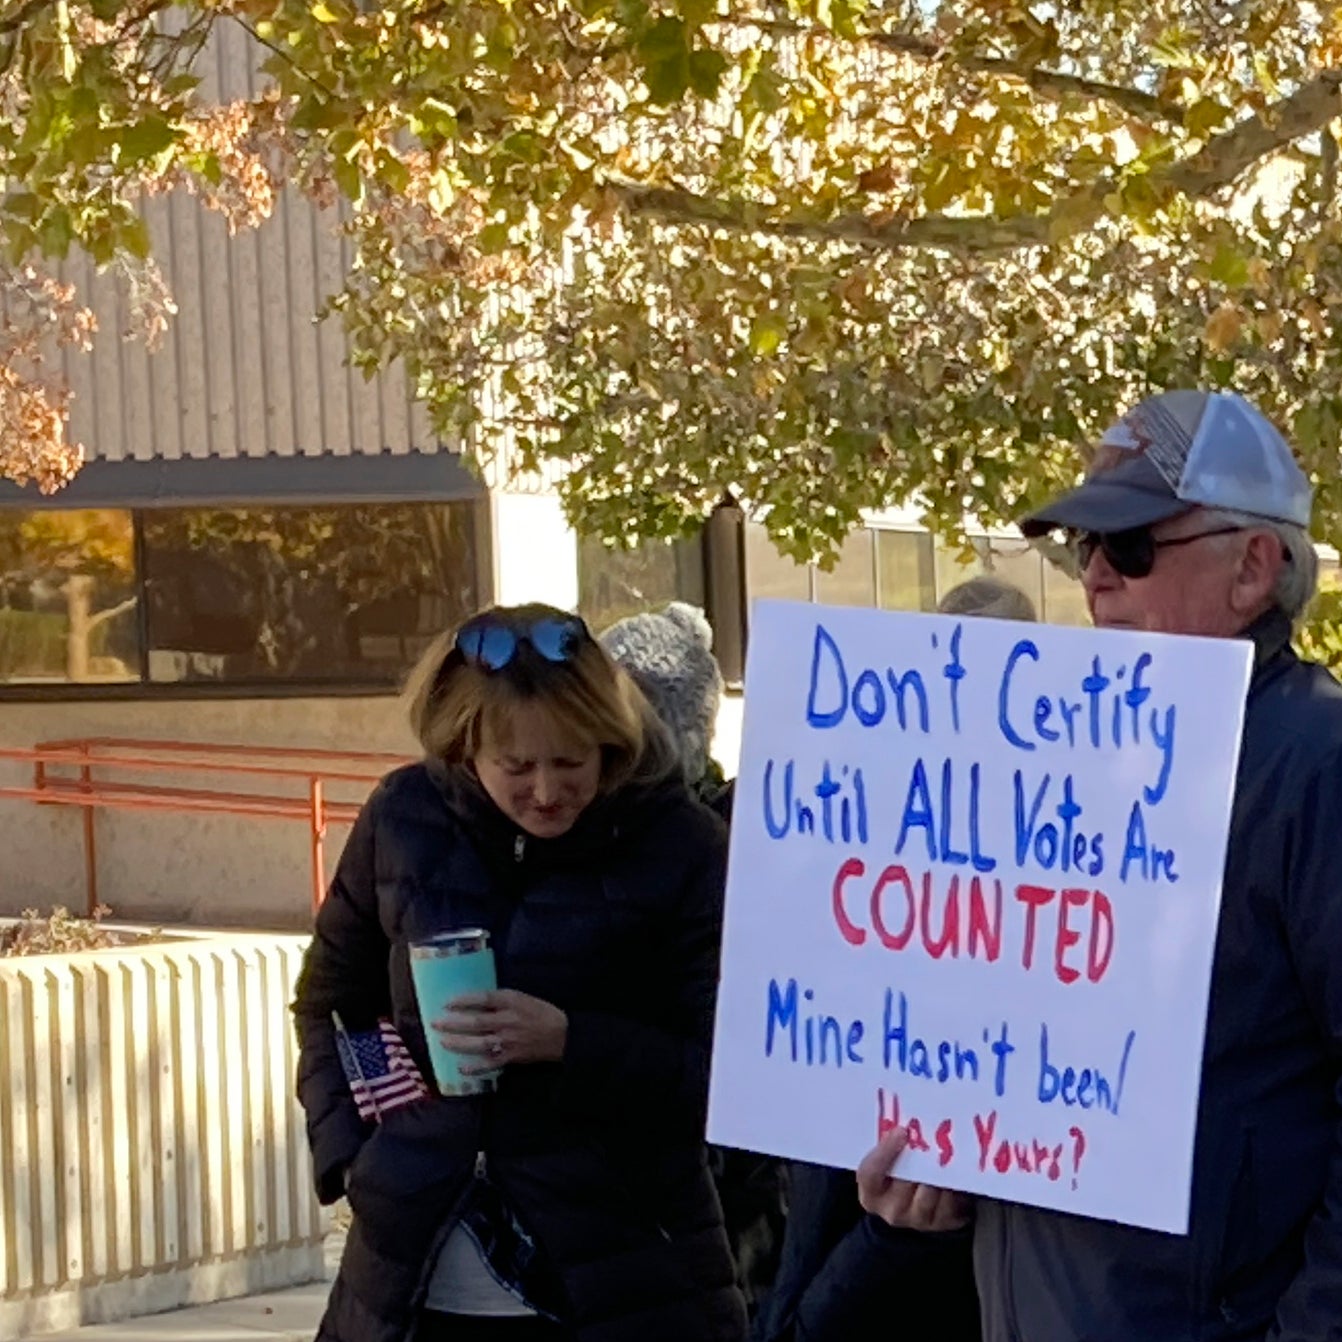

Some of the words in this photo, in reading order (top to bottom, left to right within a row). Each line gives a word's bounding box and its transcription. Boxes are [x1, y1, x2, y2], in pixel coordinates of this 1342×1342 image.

[806, 623, 966, 733] Don't
[998, 639, 1176, 805] Certify
[763, 758, 868, 844] Until
[894, 757, 997, 873] ALL
[1014, 769, 1104, 877] Votes
[1120, 800, 1180, 883] Are
[832, 857, 1115, 984] COUNTED
[765, 977, 864, 1068] Mine
[884, 986, 1016, 1097] Hasn't
[878, 1087, 954, 1168] Has
[973, 1110, 1085, 1191] Yours?
